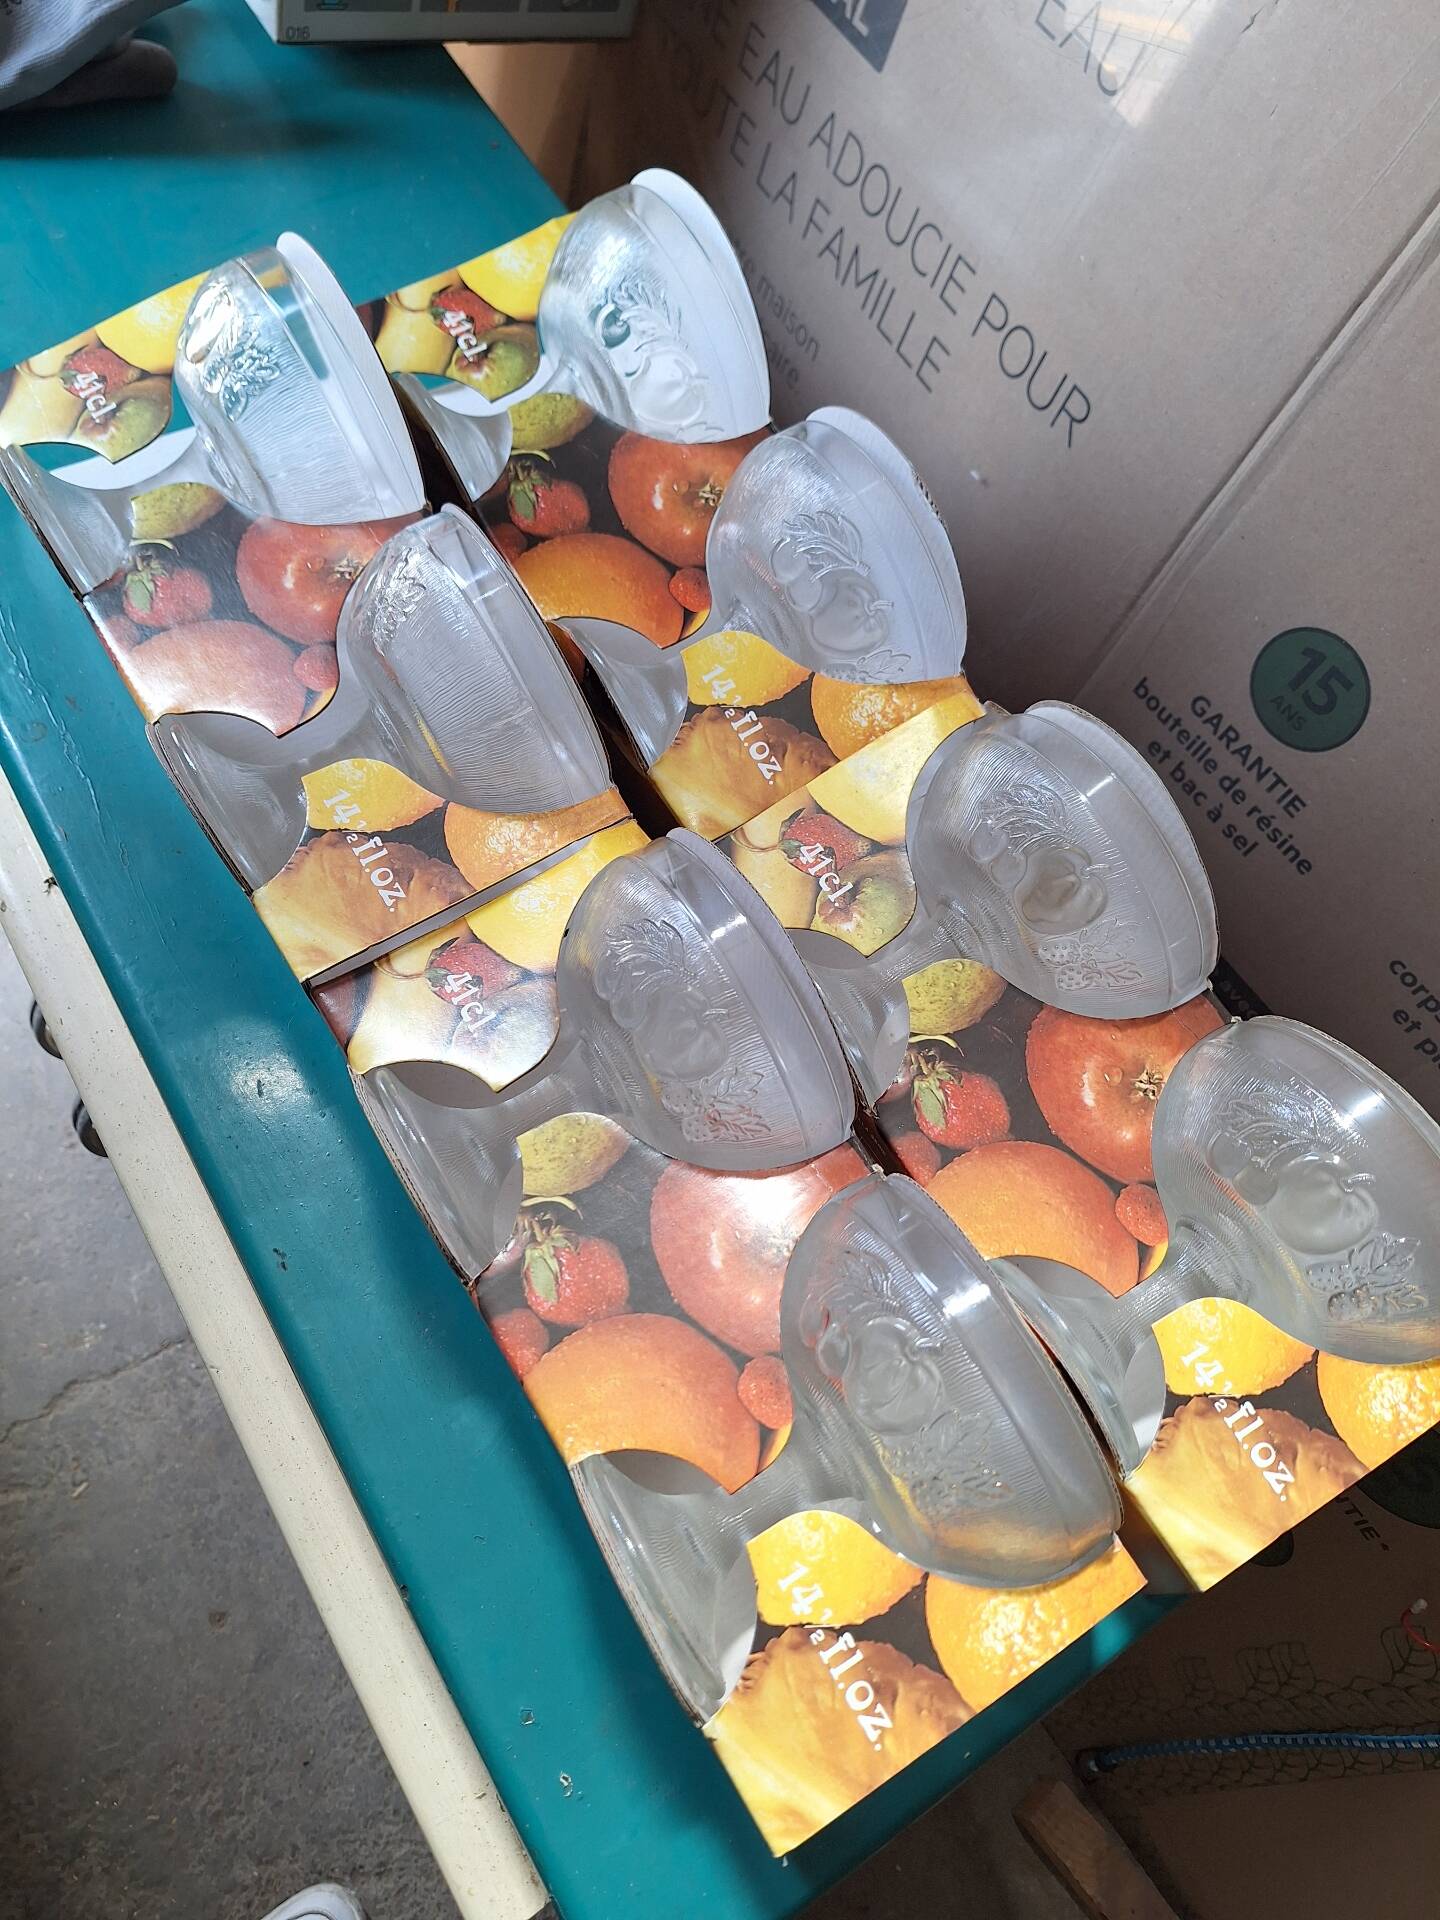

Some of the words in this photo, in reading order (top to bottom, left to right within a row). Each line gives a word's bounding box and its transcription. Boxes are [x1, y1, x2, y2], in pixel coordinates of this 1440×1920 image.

[739, 21, 811, 125] EAU
[809, 111, 977, 315] ADOUCIE
[971, 293, 1091, 448] POUR
[756, 142, 797, 224] LA
[802, 197, 951, 393] FAMILLE
[757, 275, 820, 362] maison
[1268, 693, 1308, 732] ANS
[1287, 646, 1354, 716] 15
[1133, 676, 1219, 775] bouteille
[1219, 771, 1248, 806] de
[1249, 804, 1314, 876] résine
[1147, 738, 1170, 765] et
[1169, 761, 1212, 808] bac
[1206, 803, 1223, 823] à
[1221, 821, 1260, 858] sel
[1190, 695, 1307, 819] GARANTIE
[1389, 960, 1440, 1025] corp
[1392, 1009, 1421, 1033] et
